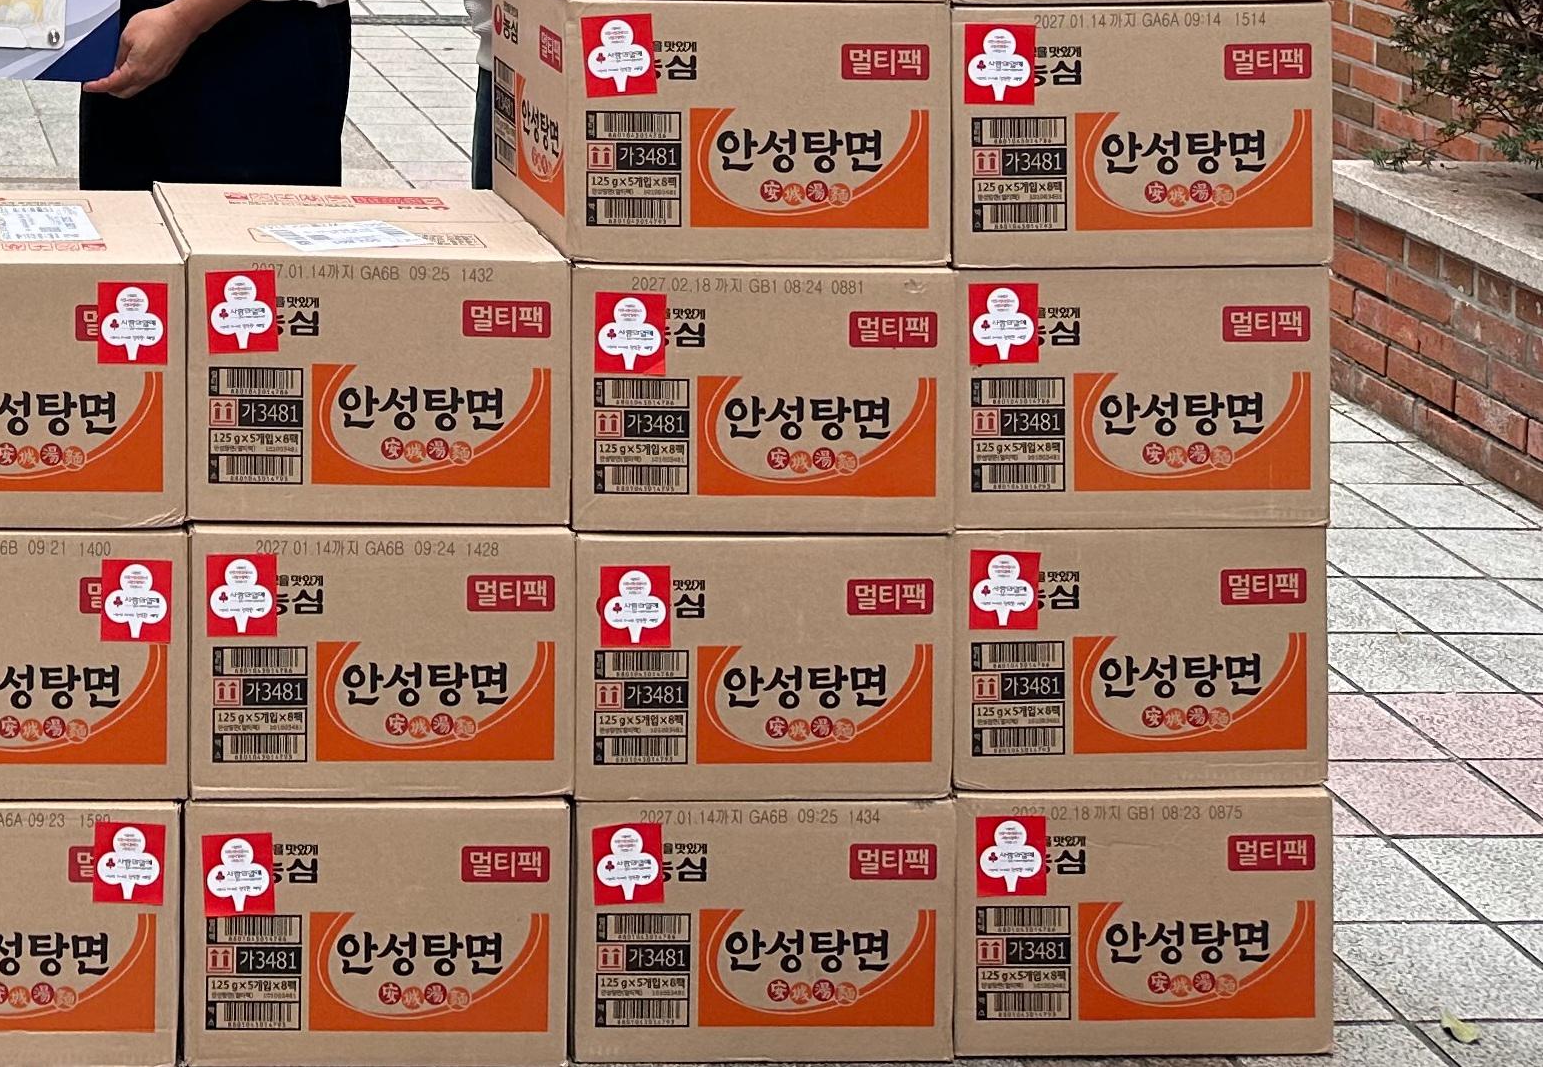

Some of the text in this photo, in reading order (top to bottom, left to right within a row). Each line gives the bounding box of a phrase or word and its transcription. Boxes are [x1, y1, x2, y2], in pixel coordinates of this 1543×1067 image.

[1142, 13, 1179, 27] GA6A
[1235, 12, 1266, 25] 1514
[849, 48, 921, 76] 멀티팩
[1232, 46, 1303, 76] 멀티팩
[521, 97, 559, 157] 안성탕면
[619, 147, 677, 167] 가3481
[716, 128, 883, 172] 안성탕면
[1005, 151, 1062, 172] 가3481
[1100, 129, 1266, 175] 안성탕면
[360, 265, 399, 280] GA6B
[461, 267, 493, 282] 1432
[749, 278, 777, 293] GB1
[831, 279, 863, 294] 0881
[470, 305, 543, 333] 멀티팩
[857, 315, 929, 343] 멀티팩
[1230, 309, 1302, 338] 멀티팩
[241, 403, 299, 423] 가3481
[337, 385, 504, 431] 안성탕면
[724, 395, 891, 440] 안성탕면
[1004, 412, 1061, 432] 가3481
[1099, 391, 1264, 436] 안성탕면
[627, 414, 685, 434] 가3481
[79, 541, 111, 556] 1400
[365, 541, 404, 555] GA6B
[467, 541, 499, 556] 1428
[475, 579, 547, 608] 멀티팩
[855, 582, 925, 611] 멀티팩
[1228, 571, 1299, 601] 멀티팩
[342, 661, 509, 706] 안성탕면
[722, 664, 888, 709] 안성탕면
[1004, 676, 1061, 697] 가3481
[1098, 652, 1262, 699] 안성탕면
[246, 682, 303, 702] 가3481
[627, 685, 684, 705] 가3481
[748, 809, 788, 823] GA6B
[797, 809, 838, 823] 09:25
[849, 809, 880, 823] 1434
[470, 850, 541, 878] 멀티팩
[857, 848, 929, 876] 멀티팩
[1236, 838, 1307, 867] 멀티팩
[336, 932, 504, 975] 안성탕면
[724, 929, 890, 972] 안성탕면
[1009, 941, 1066, 961] 가3481
[1105, 919, 1270, 964] 안성탕면
[239, 950, 297, 970] 가3481
[629, 948, 686, 968] 가3481
